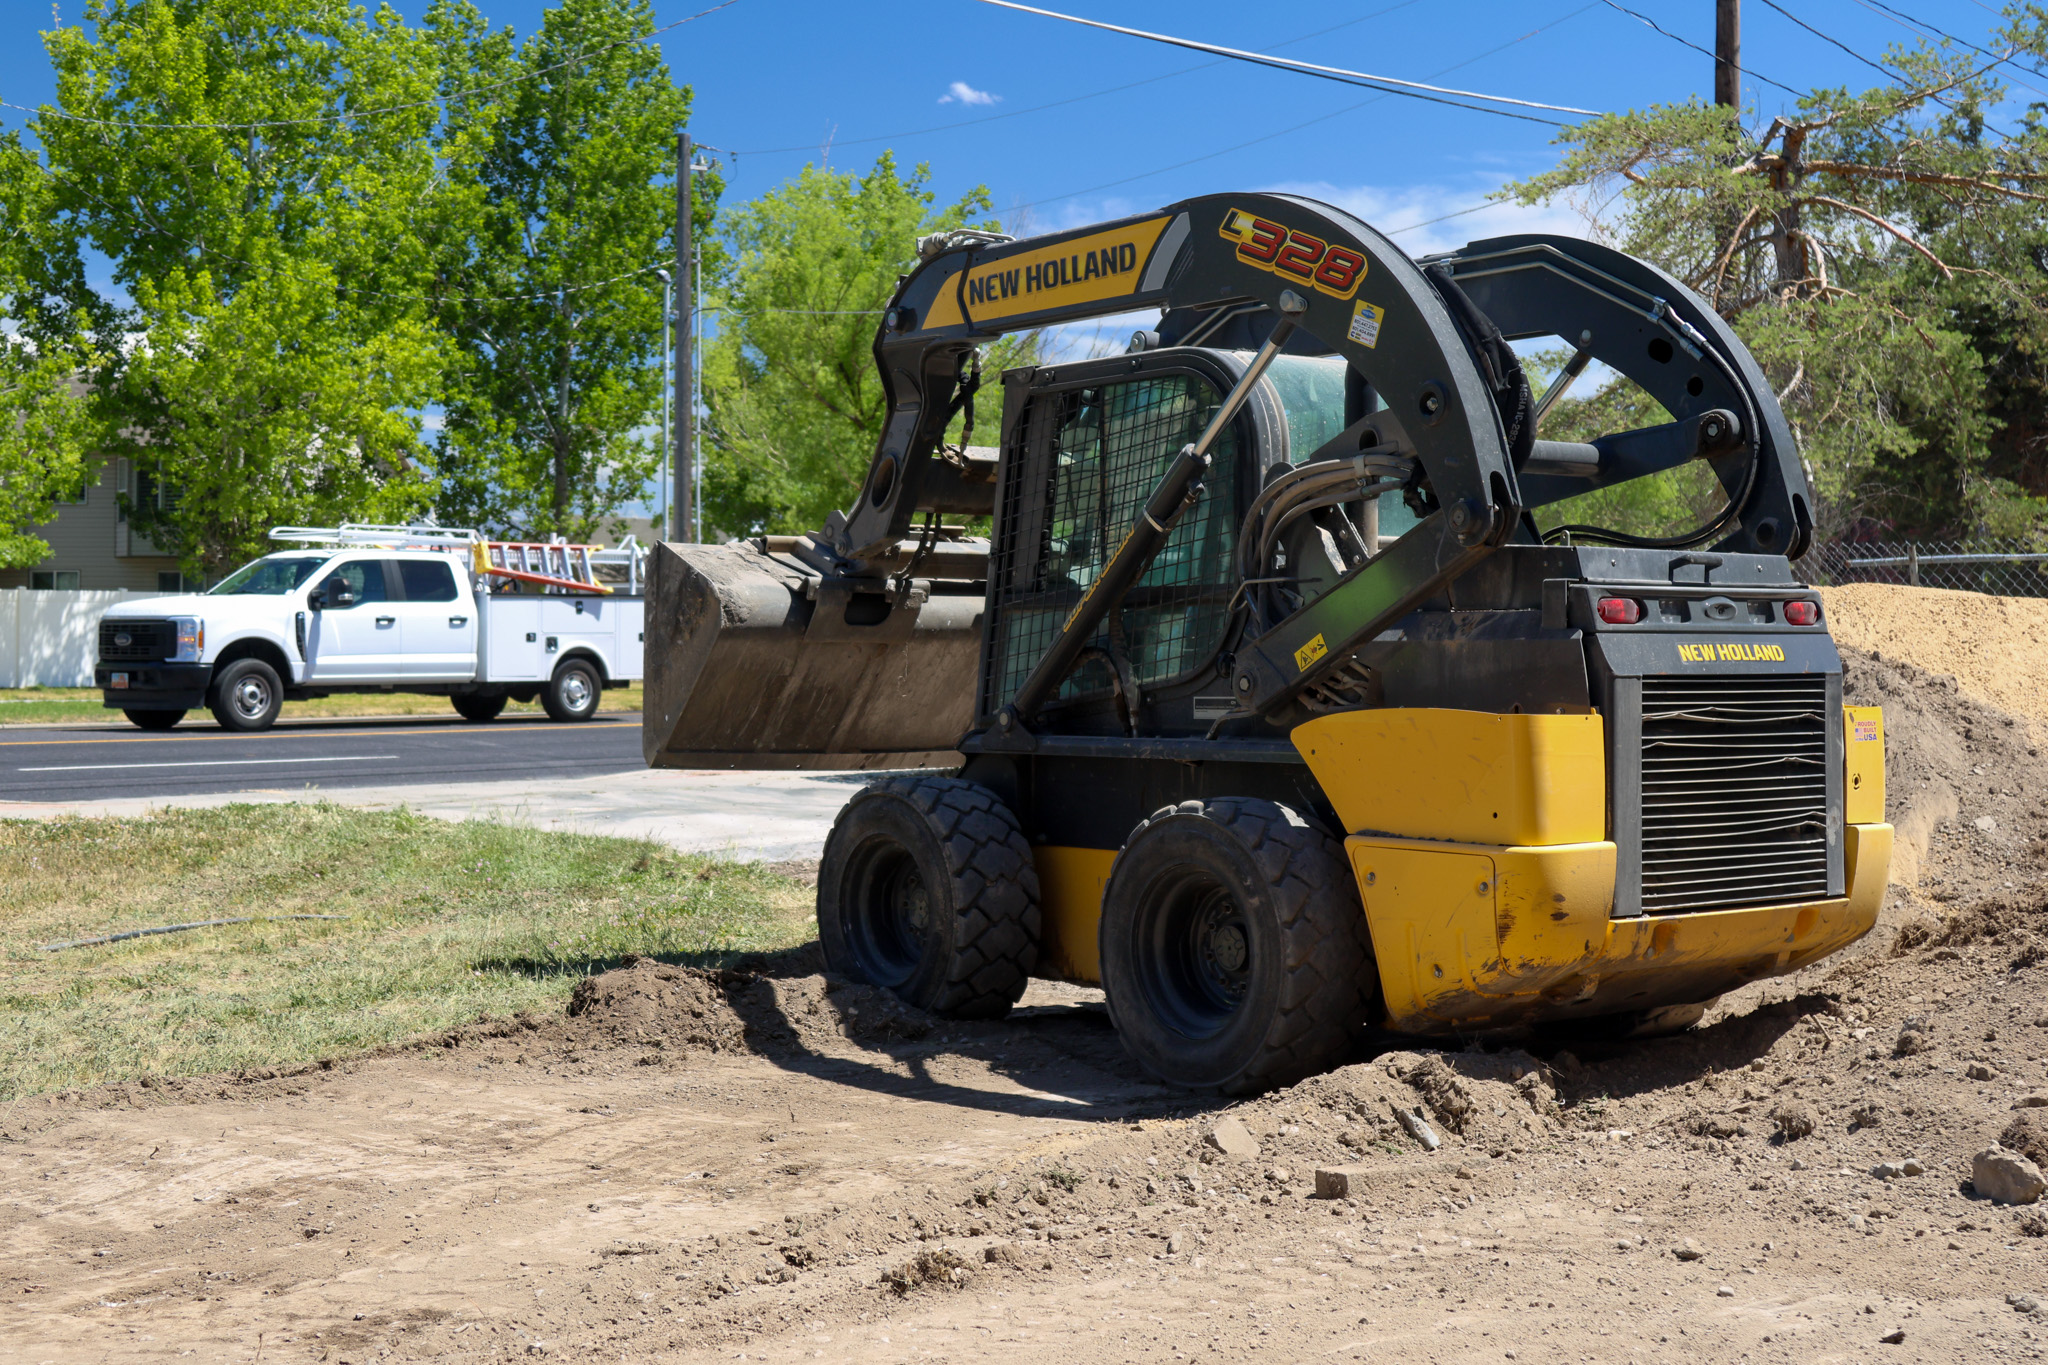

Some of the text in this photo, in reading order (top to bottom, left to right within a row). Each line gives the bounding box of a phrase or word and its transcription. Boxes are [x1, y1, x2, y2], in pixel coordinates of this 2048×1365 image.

[969, 242, 1136, 306] NEW HOLLAND
[1519, 383, 1529, 411] MSHA
[1677, 644, 1785, 662] NEW HOLLAND
